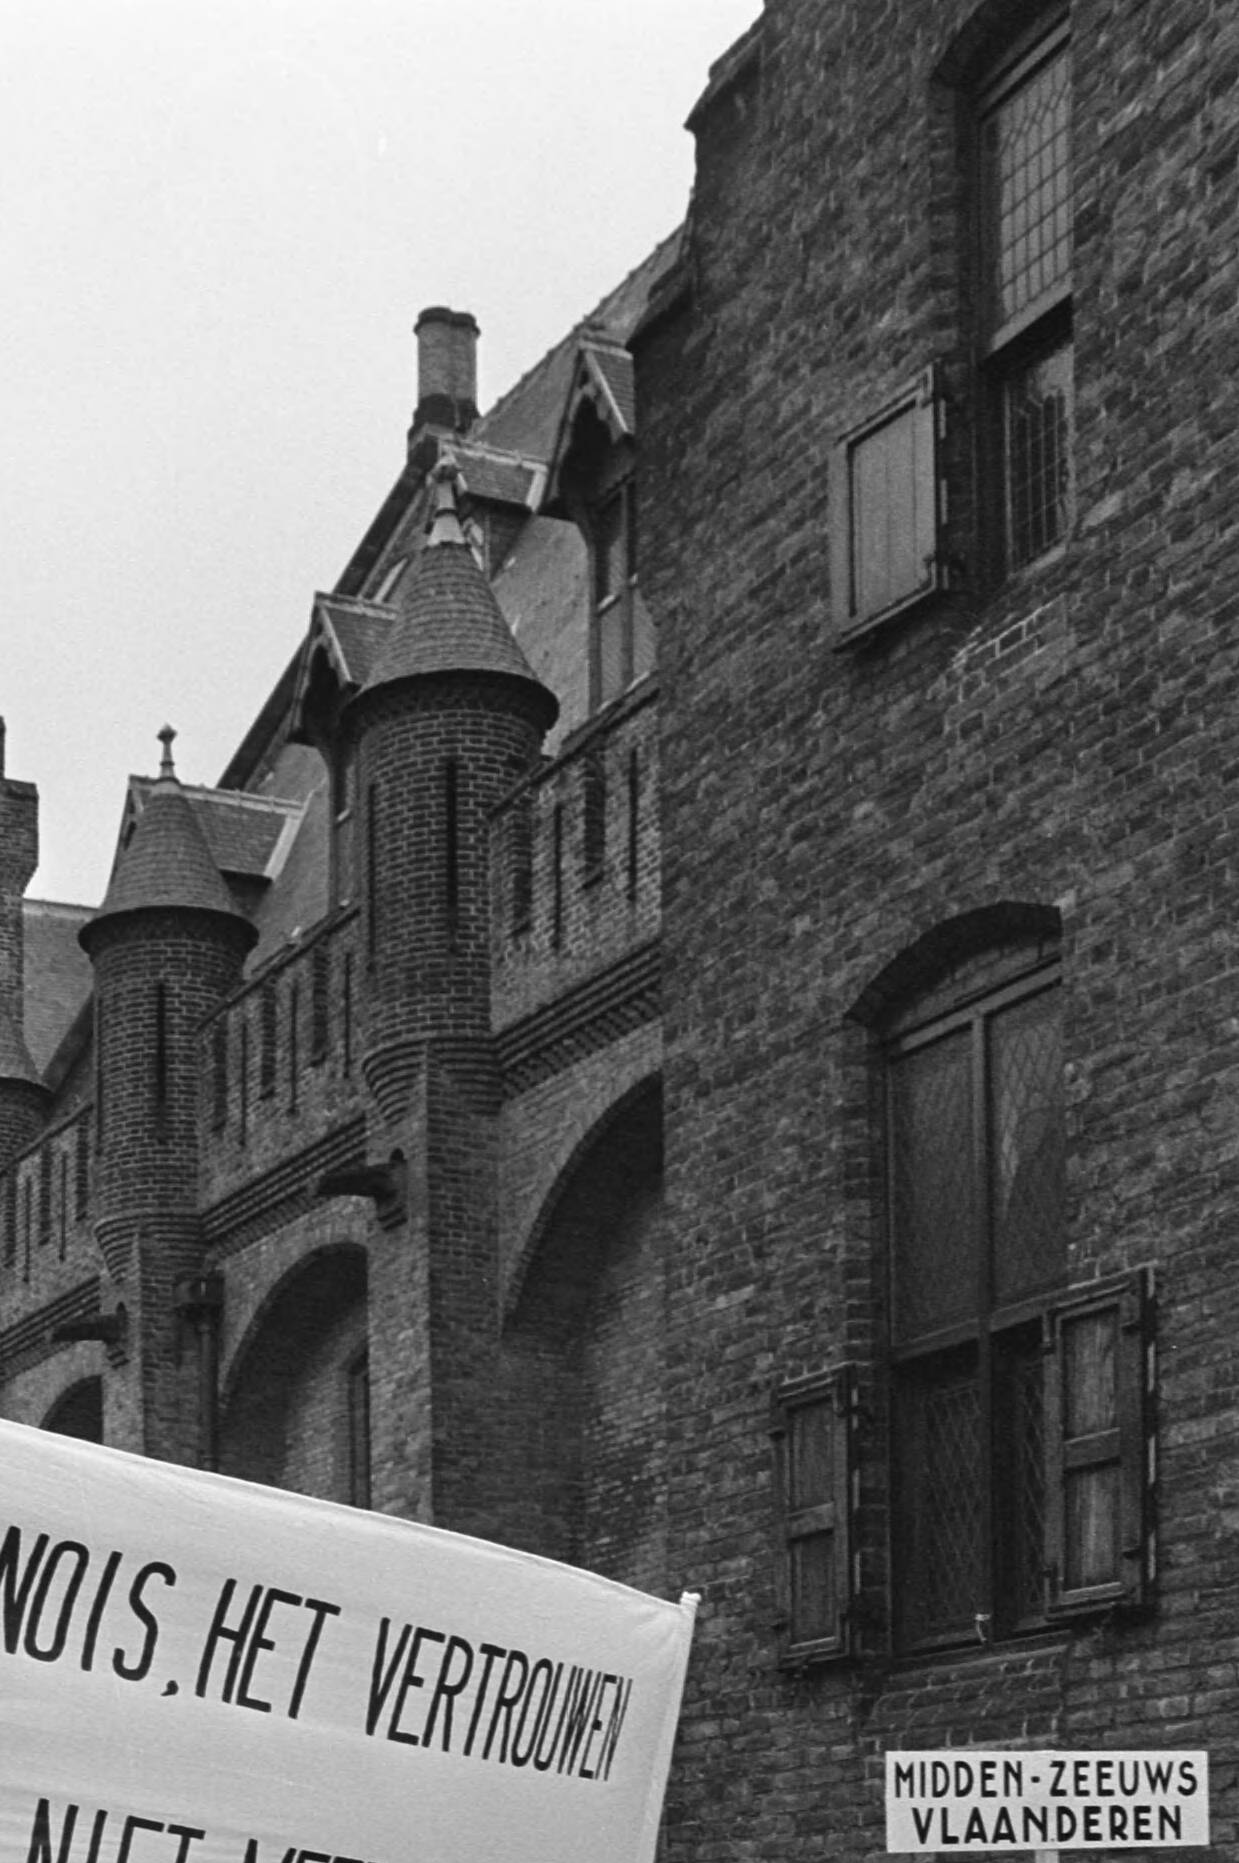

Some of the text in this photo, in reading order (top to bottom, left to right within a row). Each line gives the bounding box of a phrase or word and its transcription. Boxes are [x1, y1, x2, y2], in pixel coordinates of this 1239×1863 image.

[195, 1578, 343, 1720] HET
[365, 1617, 633, 1781] VERTROUWEN
[911, 1804, 1182, 1845] VLAANDEREN
